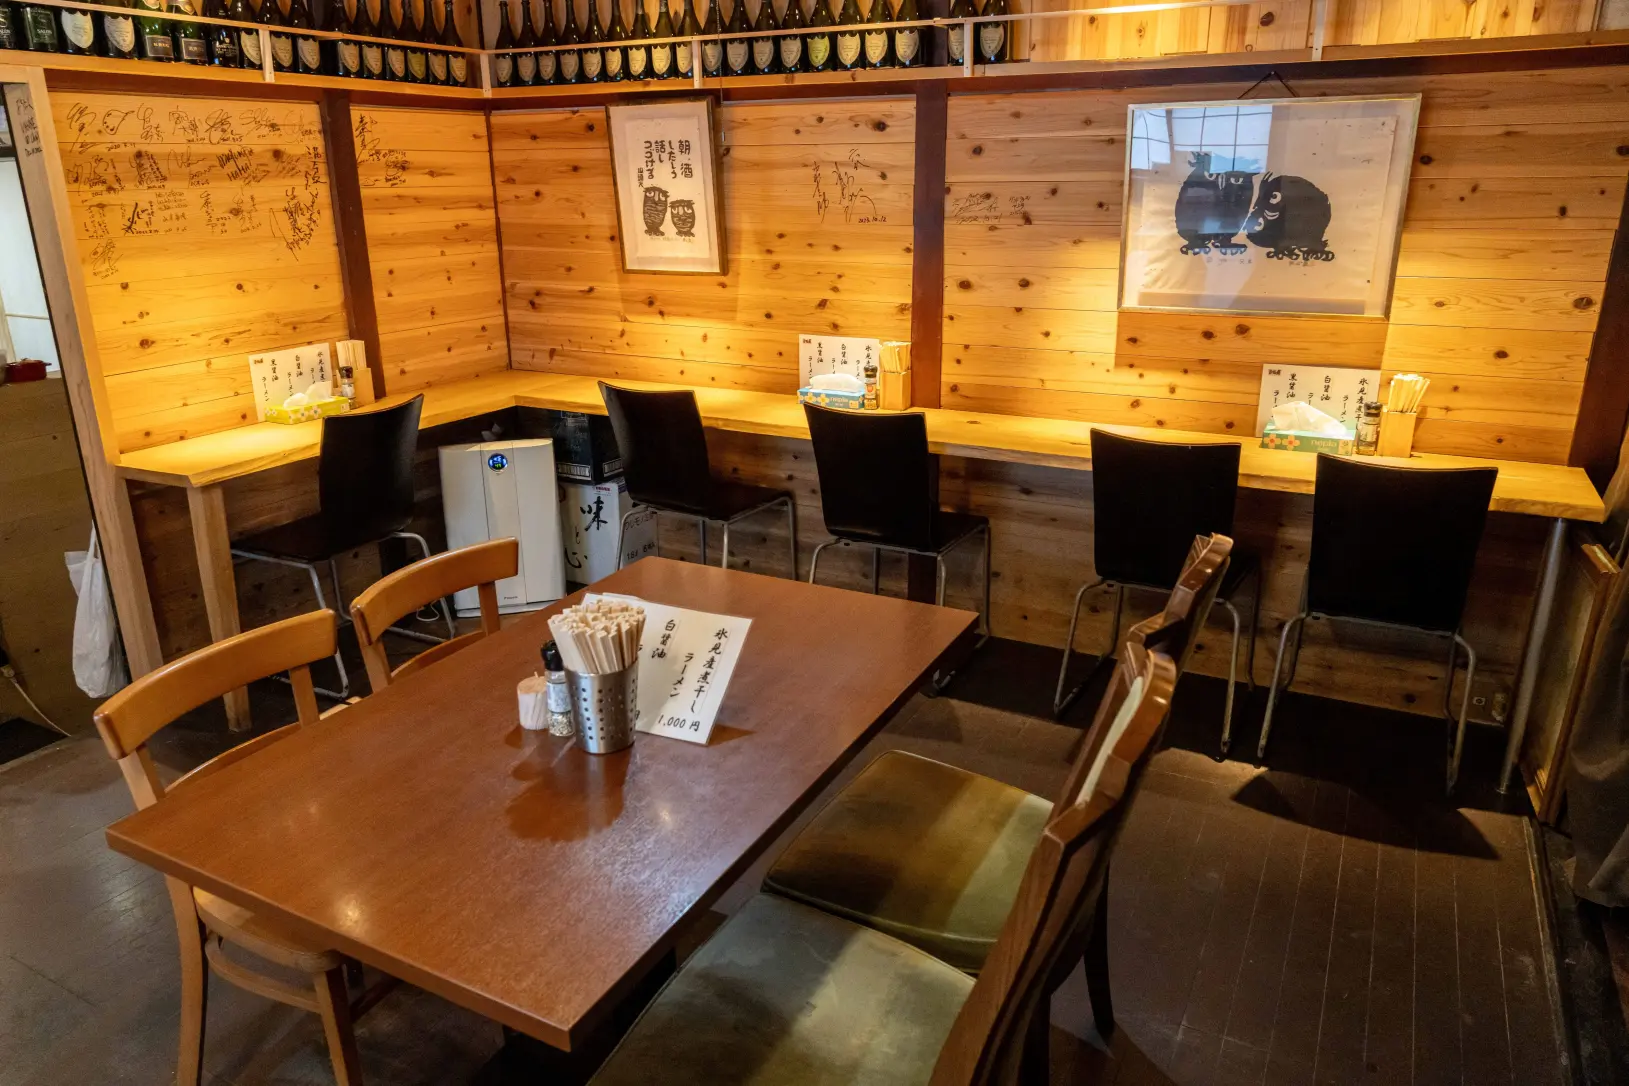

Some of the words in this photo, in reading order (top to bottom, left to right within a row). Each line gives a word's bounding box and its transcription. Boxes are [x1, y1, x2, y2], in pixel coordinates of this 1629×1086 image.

[651, 619, 676, 659] 白醤油
[670, 652, 695, 698] ラーメン
[690, 628, 729, 713] 氷見産煮干し
[689, 720, 701, 732] 円
